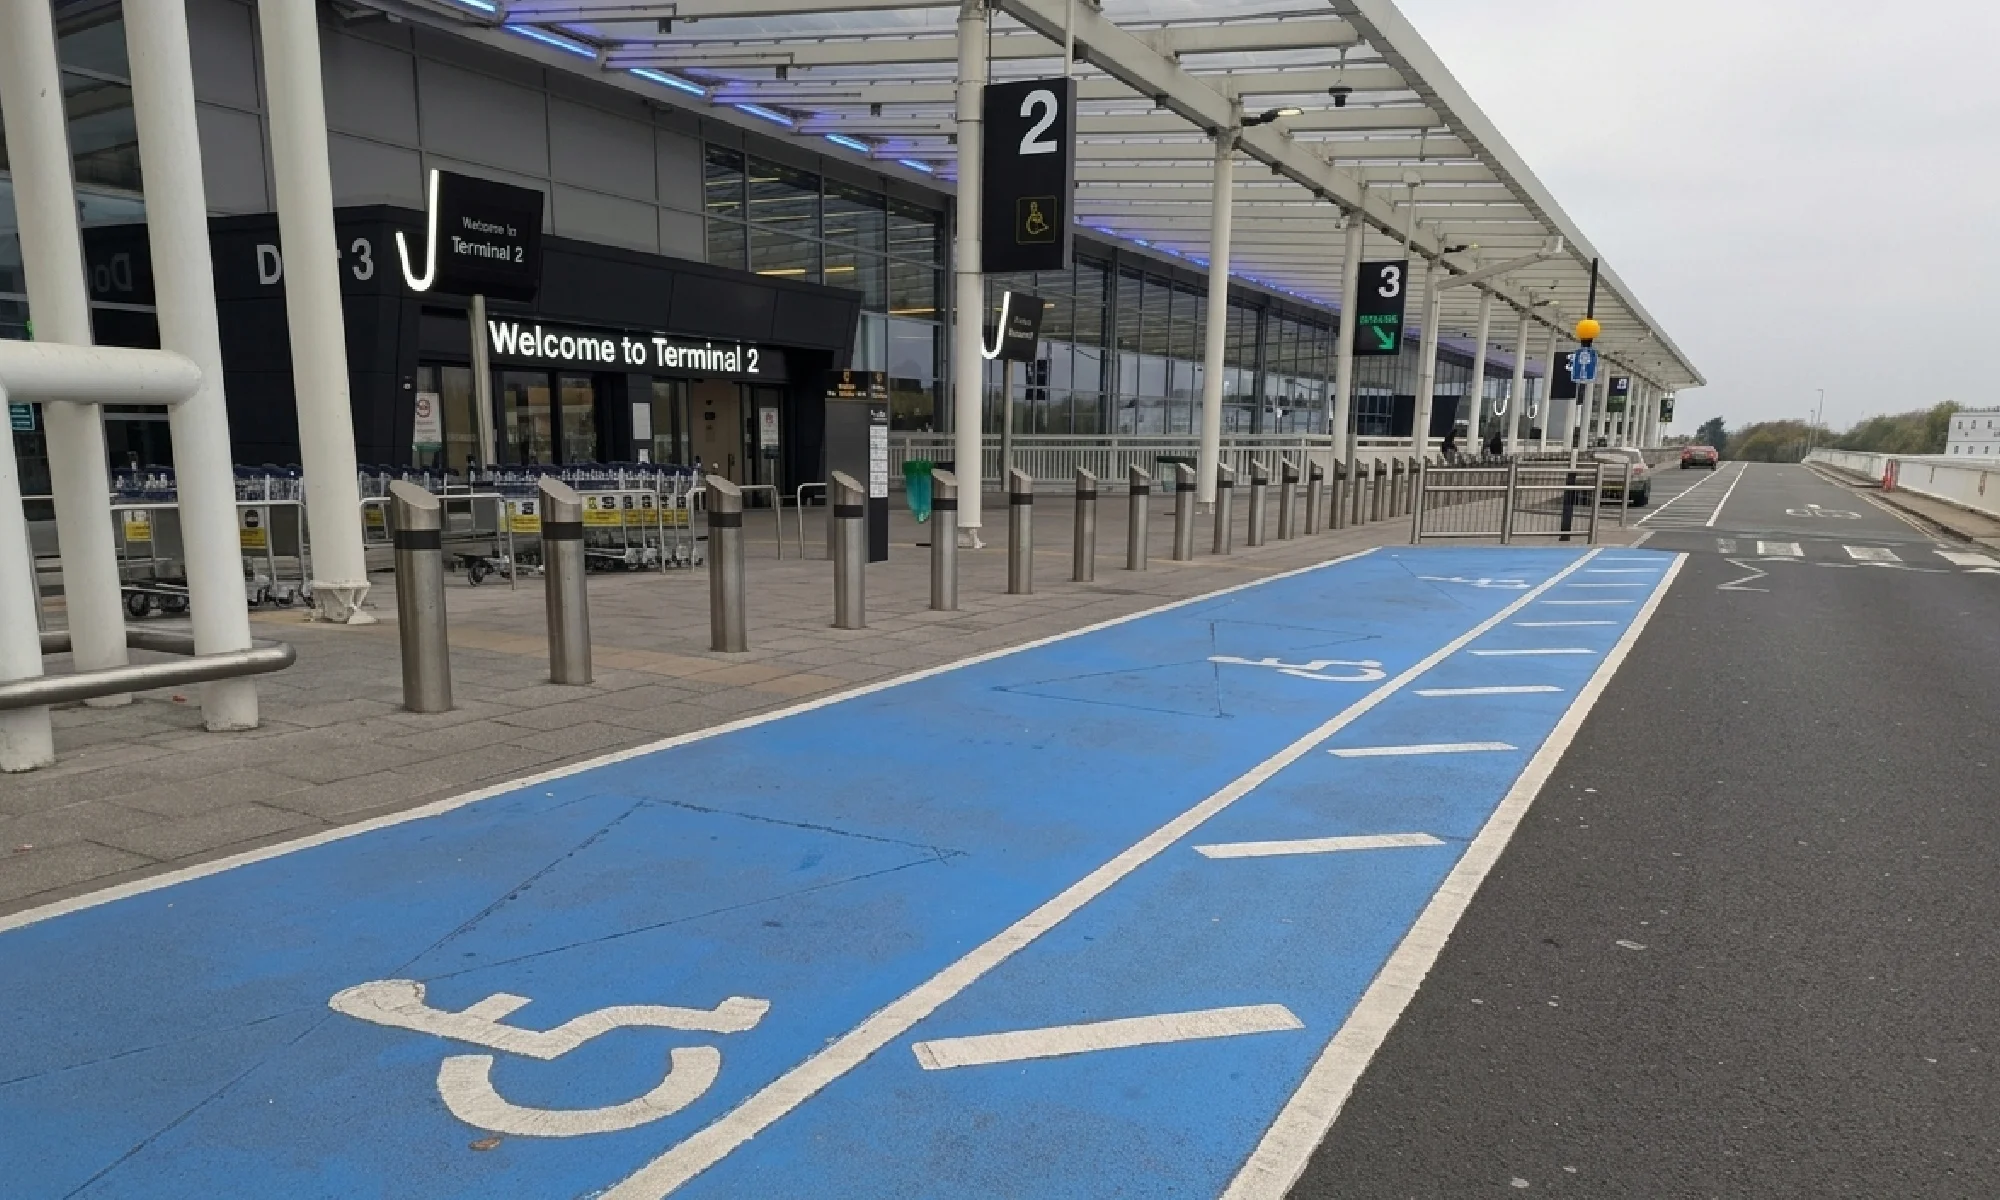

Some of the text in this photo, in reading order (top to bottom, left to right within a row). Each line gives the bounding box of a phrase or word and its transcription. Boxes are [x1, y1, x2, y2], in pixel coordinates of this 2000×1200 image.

[1019, 89, 1058, 155] 2
[351, 237, 375, 281] 3
[452, 235, 524, 263] Terminal 2
[1378, 264, 1401, 298] 3
[487, 320, 760, 374] Welcome to Terminal 2
